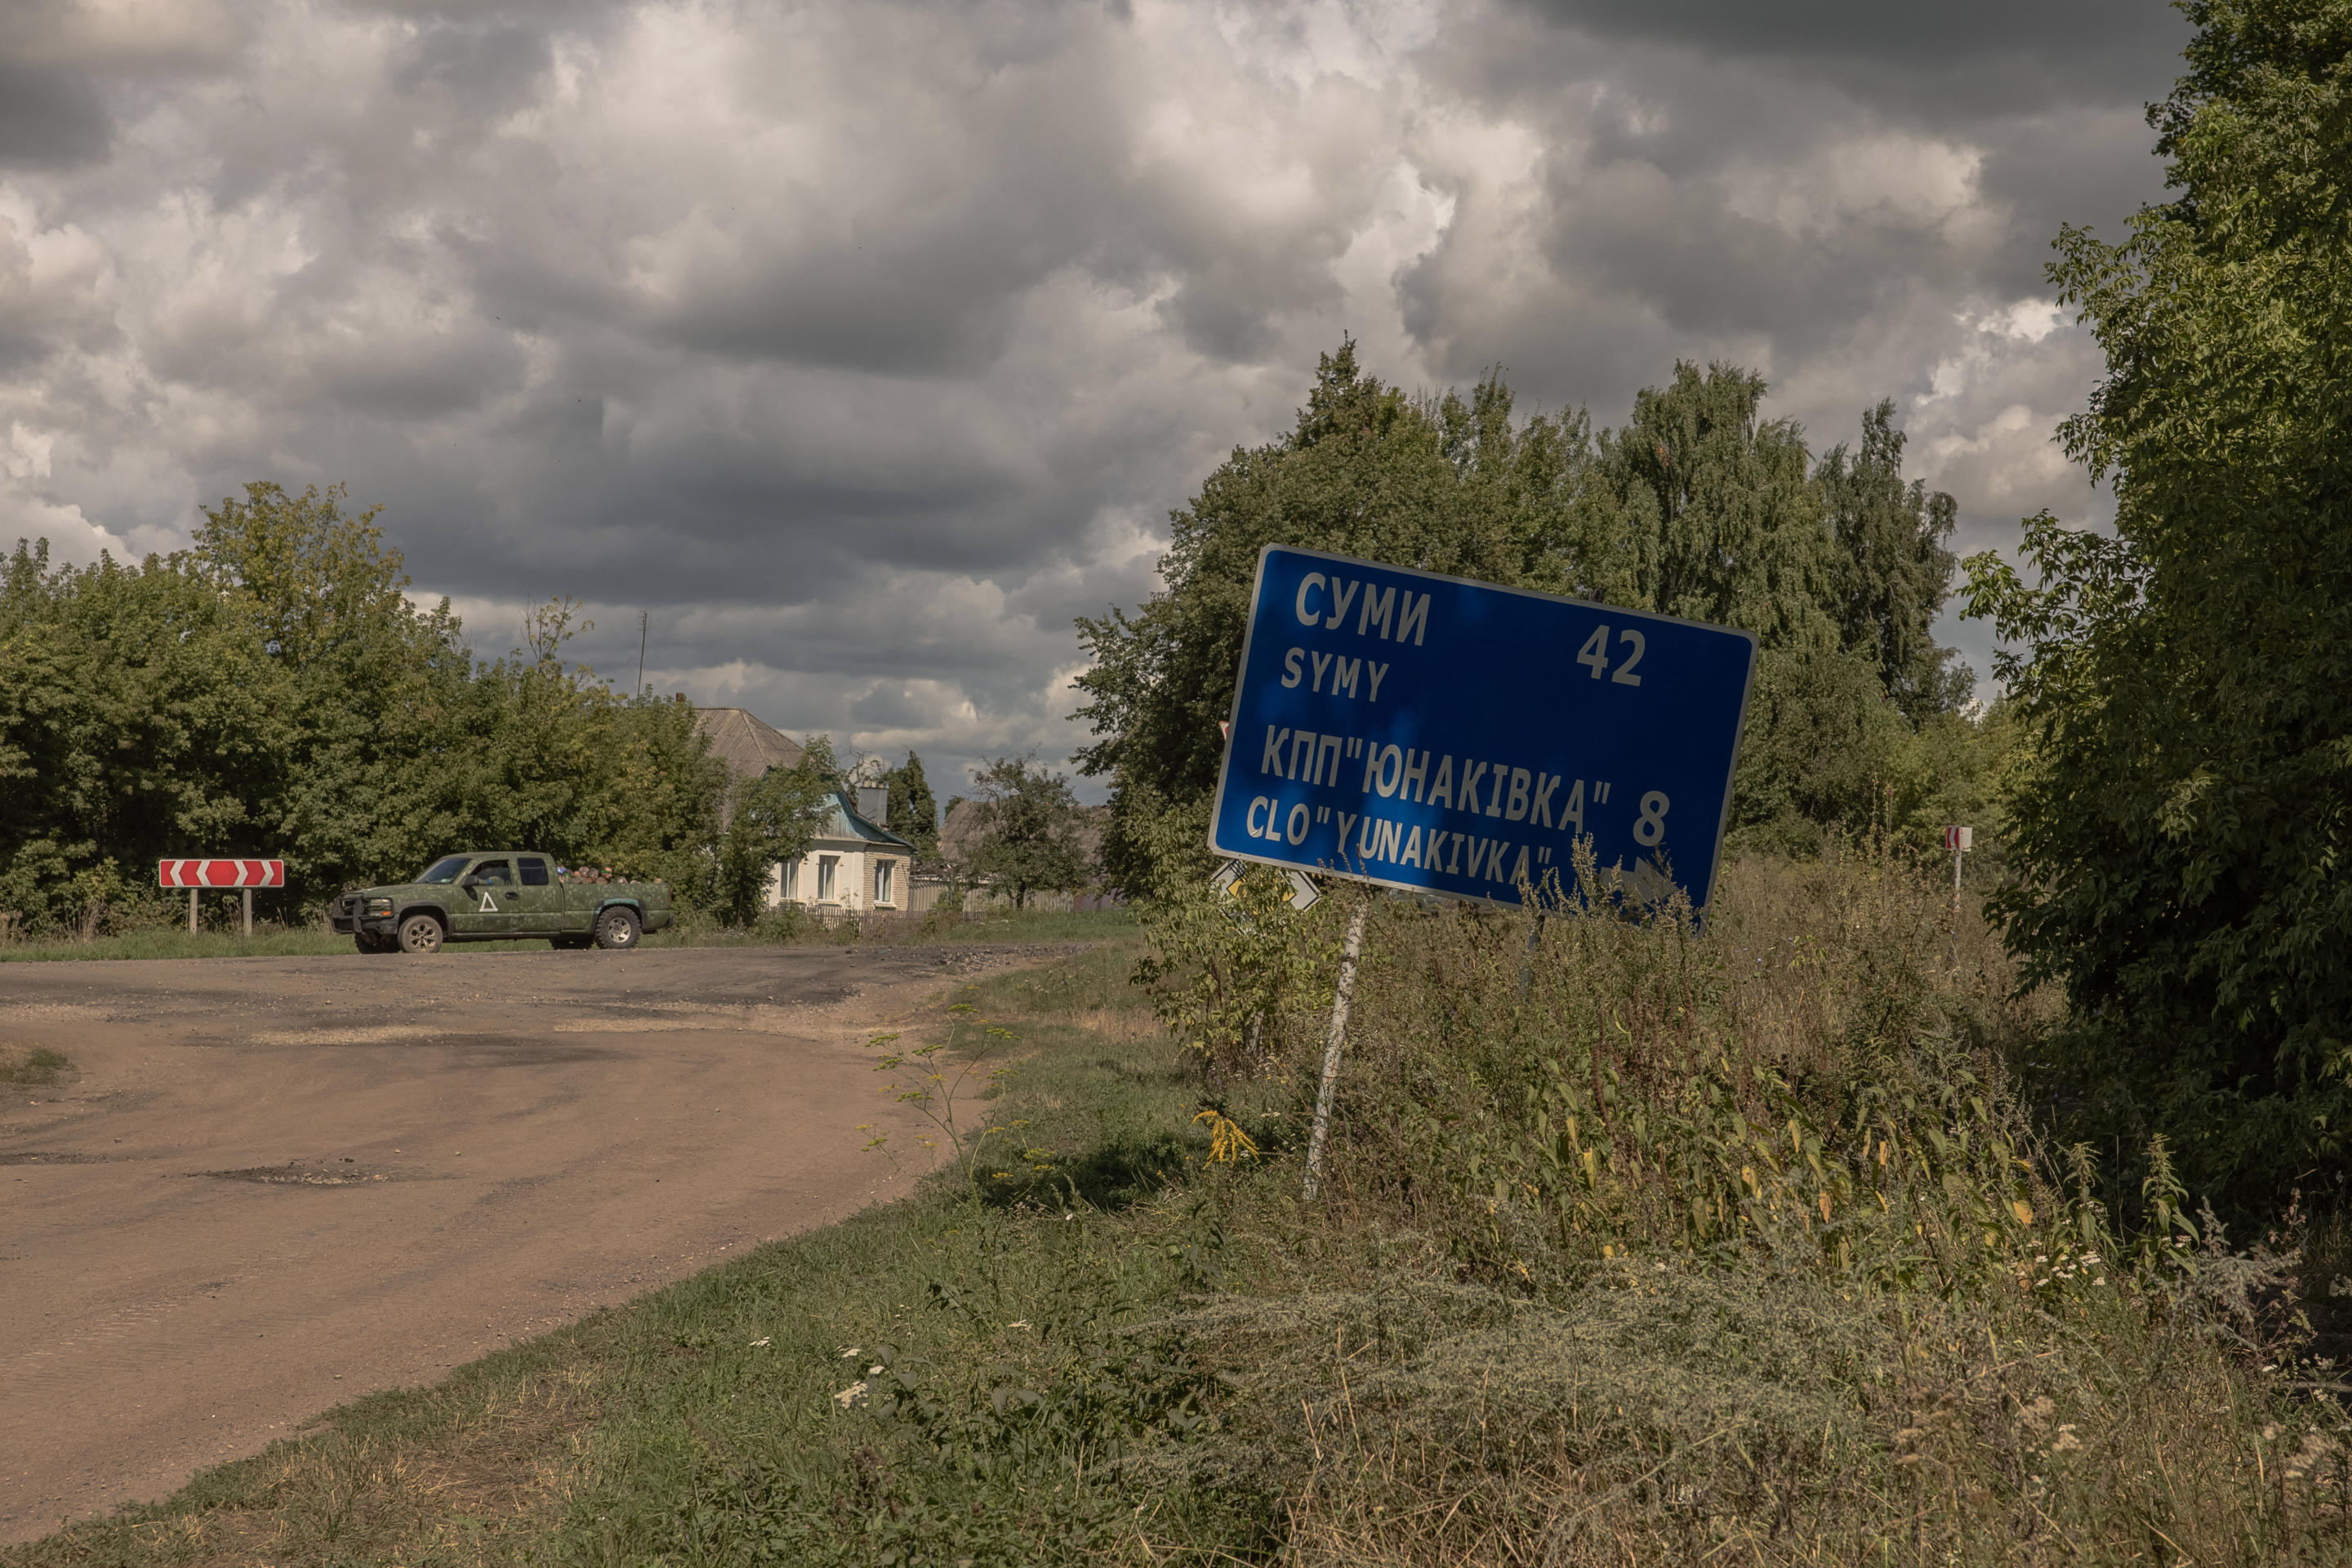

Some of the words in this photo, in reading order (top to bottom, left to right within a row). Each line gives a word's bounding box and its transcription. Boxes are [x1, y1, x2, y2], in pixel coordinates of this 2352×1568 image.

[1296, 572, 1431, 646] СУМИ
[1576, 625, 1646, 687] 42
[1281, 647, 1389, 702] SYMY
[1633, 791, 1670, 847] 8
